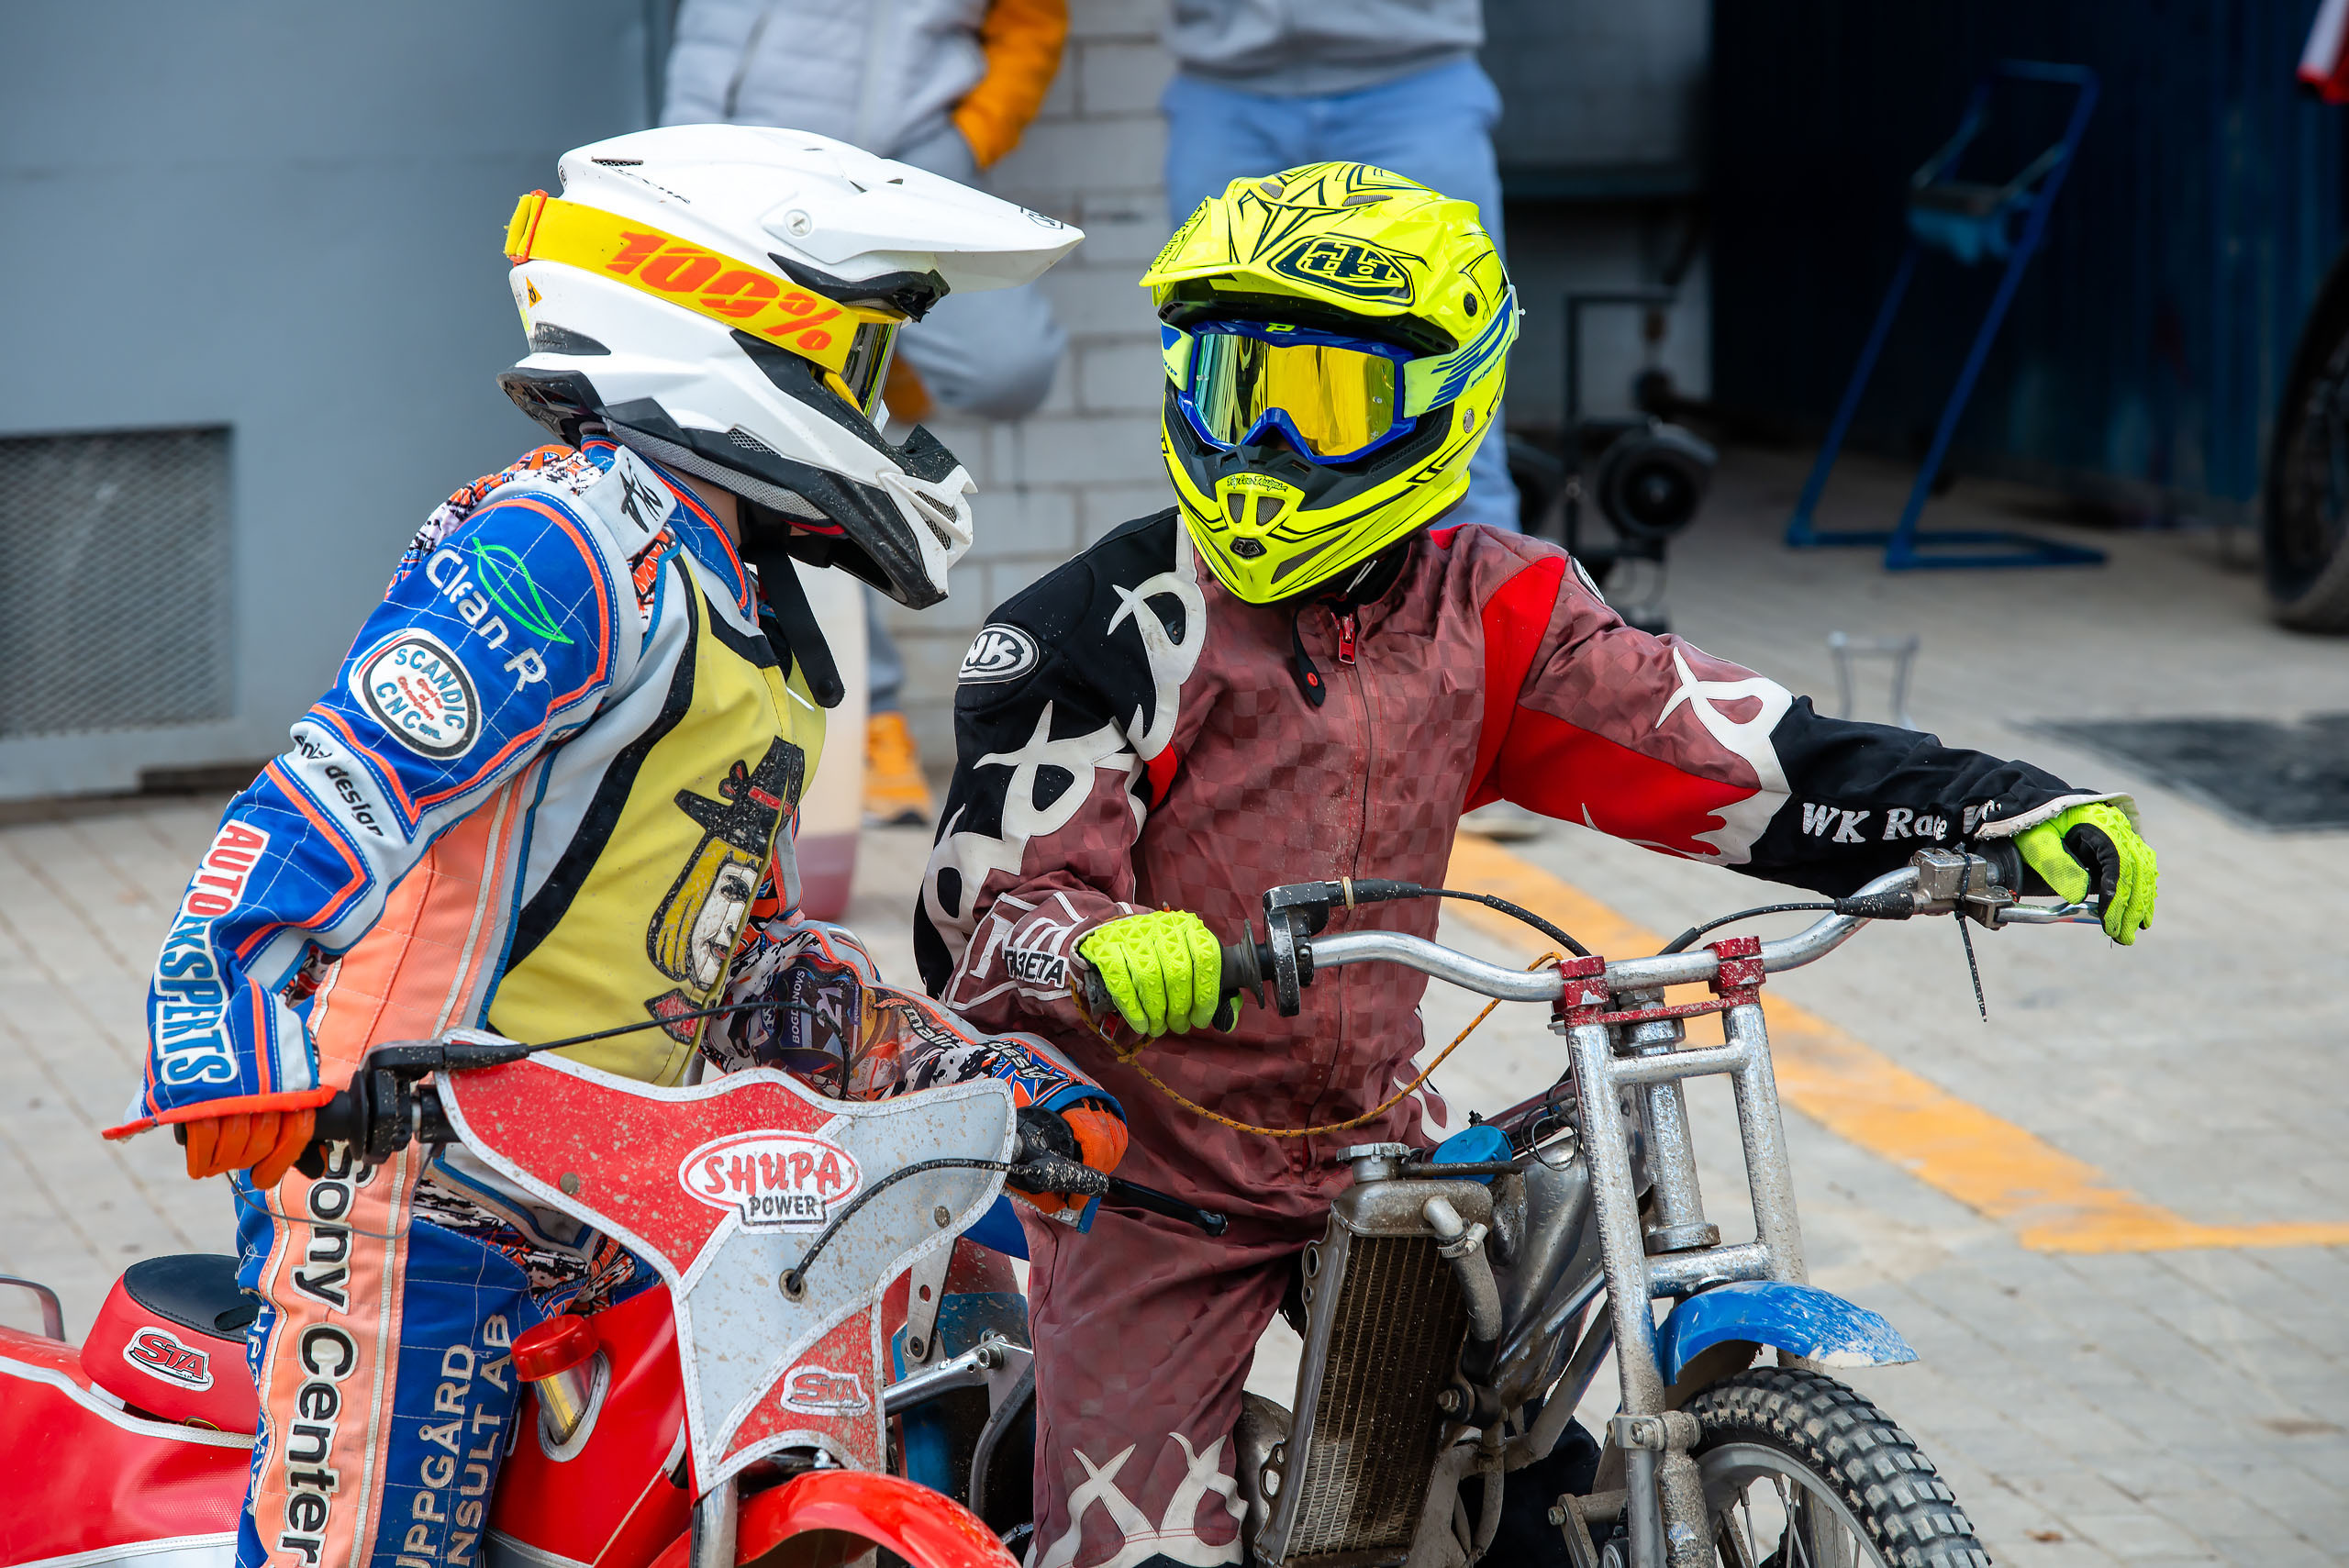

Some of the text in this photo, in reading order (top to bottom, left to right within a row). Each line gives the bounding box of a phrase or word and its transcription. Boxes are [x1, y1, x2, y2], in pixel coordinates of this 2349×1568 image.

[606, 231, 842, 350] 100%
[426, 549, 547, 692] Clean R
[375, 682, 421, 729] CNC
[395, 648, 466, 729] SCANDIC
[1802, 802, 1871, 844] WK
[816, 986, 842, 1029] 21
[704, 1151, 841, 1196] SHUPA
[748, 1195, 818, 1217] POWER
[133, 1333, 205, 1380] STA
[282, 1139, 373, 1564] Sony Center
[480, 1314, 512, 1393] AB
[792, 1373, 861, 1403] STA
